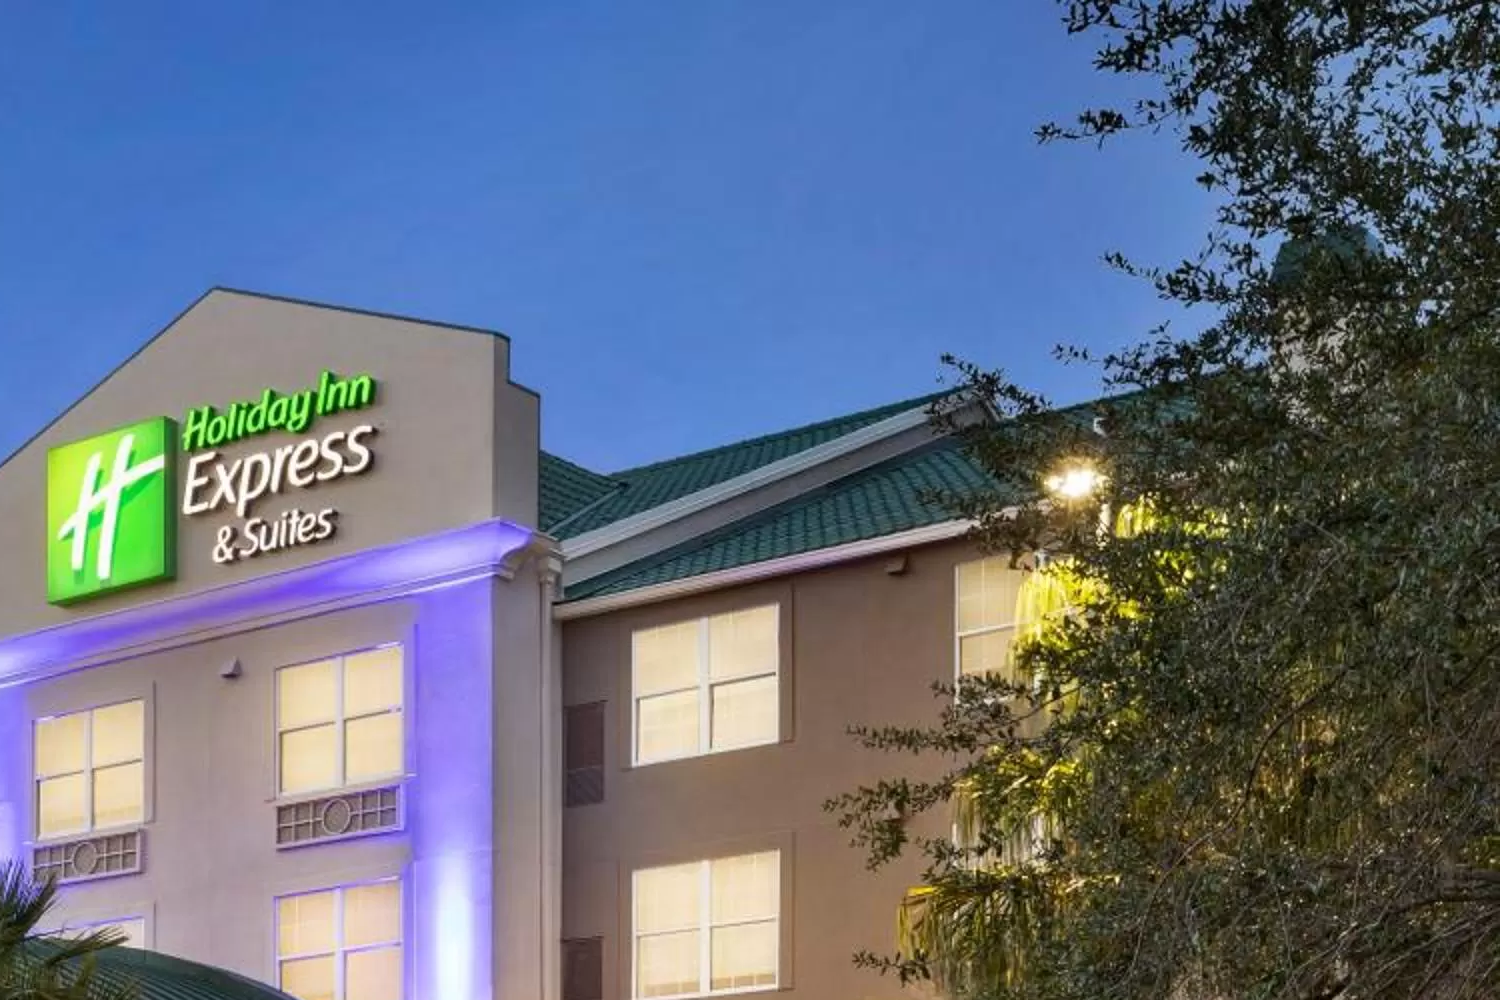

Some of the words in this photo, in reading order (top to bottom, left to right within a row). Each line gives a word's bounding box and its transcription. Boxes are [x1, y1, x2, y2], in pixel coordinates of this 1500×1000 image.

[181, 388, 312, 452] Holiday
[316, 367, 376, 416] Inn
[181, 424, 378, 519] Express
[211, 523, 238, 564] &
[239, 507, 336, 558] Suites
